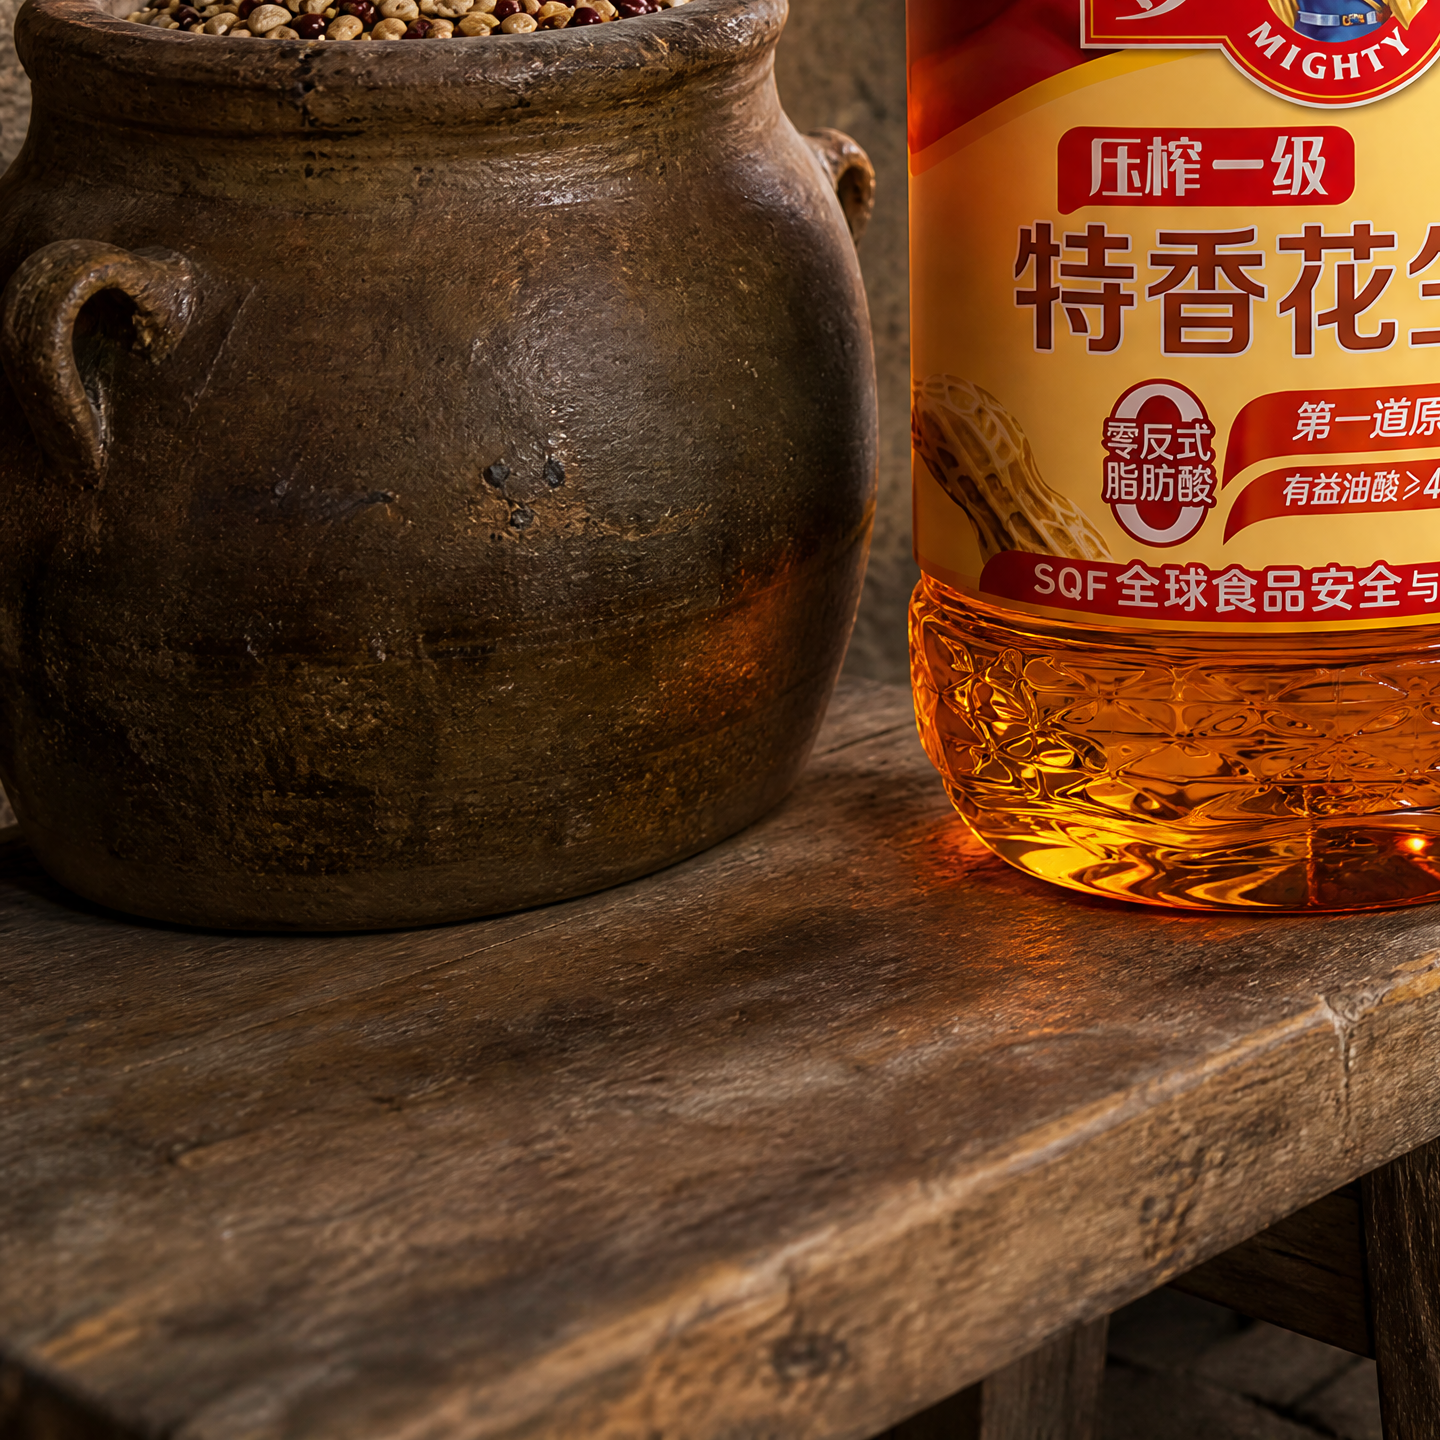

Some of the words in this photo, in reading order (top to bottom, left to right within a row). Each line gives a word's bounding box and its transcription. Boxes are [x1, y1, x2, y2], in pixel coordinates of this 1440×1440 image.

[1246, 20, 1410, 81] MIGHTY
[1088, 135, 1329, 197] 压榨一级
[1106, 421, 1212, 461] 零反式
[1105, 461, 1213, 503] 脂肪酸
[1033, 562, 1109, 602] SQF
